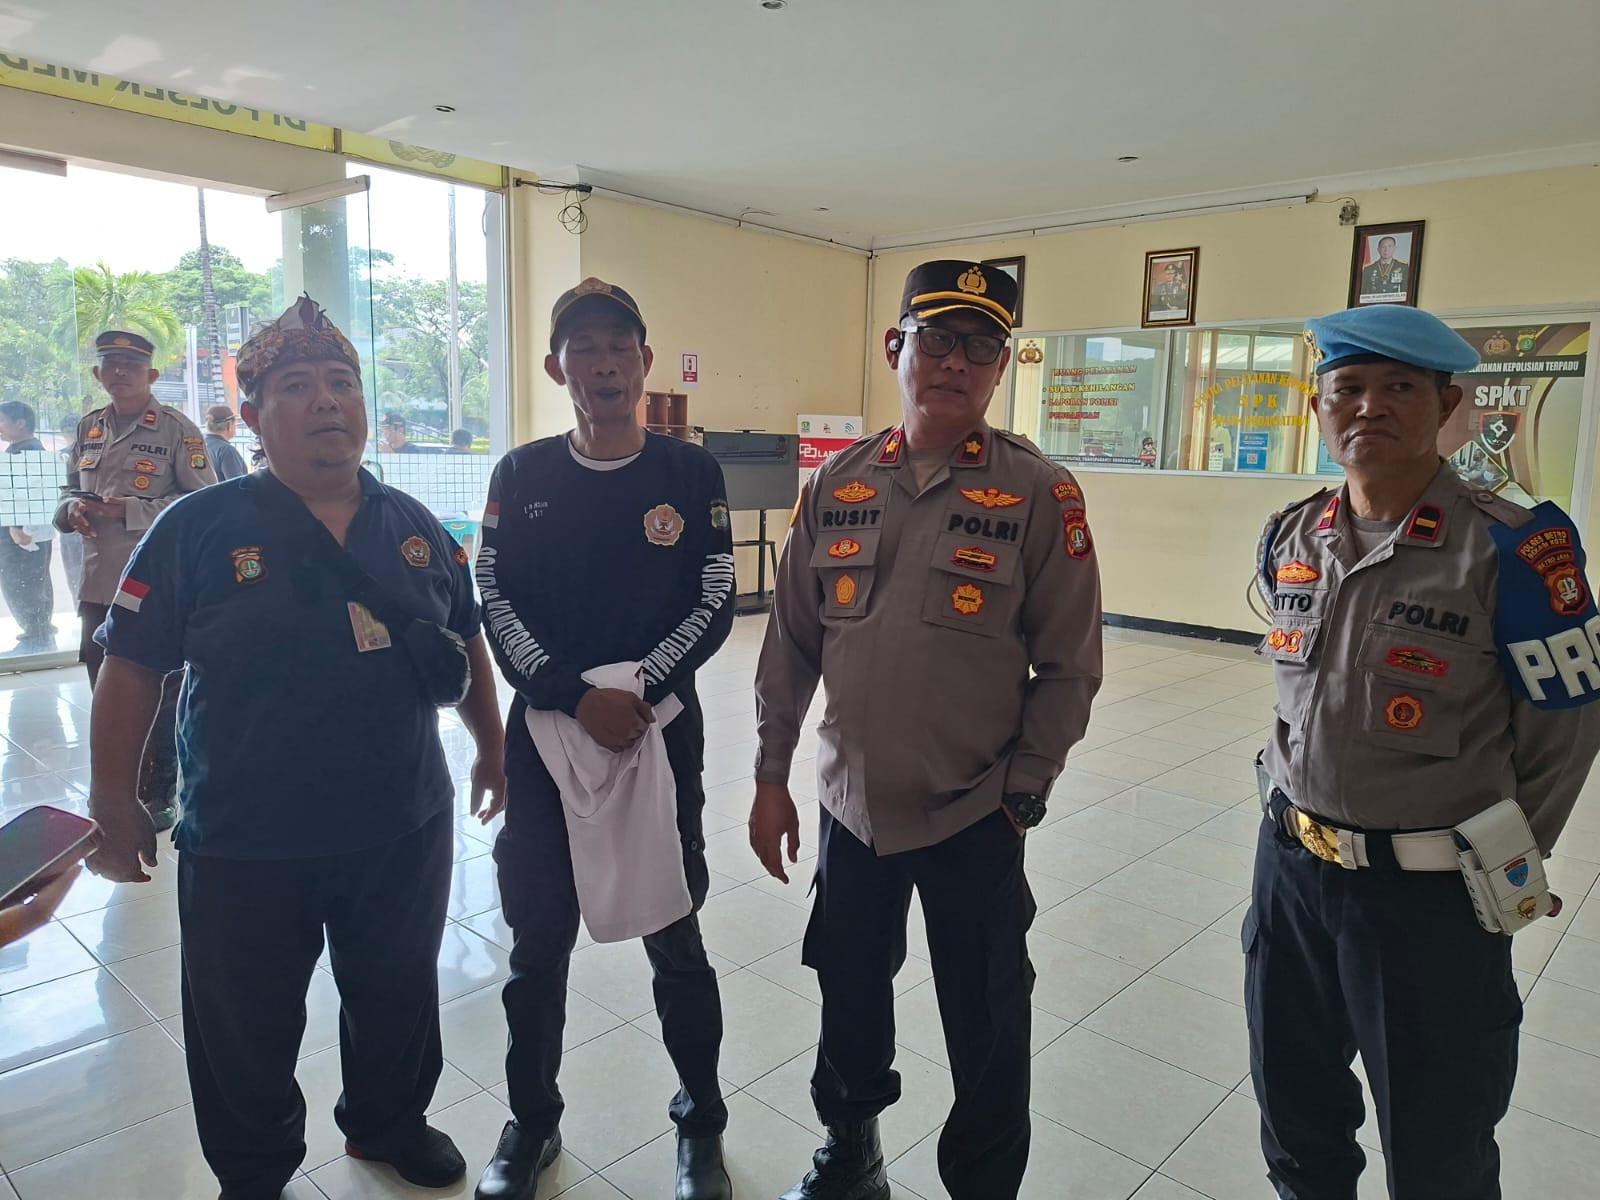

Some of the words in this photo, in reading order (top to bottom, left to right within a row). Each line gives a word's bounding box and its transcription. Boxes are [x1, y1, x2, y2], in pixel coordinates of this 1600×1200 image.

[1502, 361, 1544, 373] KEPOLISIAN
[1546, 360, 1580, 371] TERPADU
[1048, 385, 1077, 393] SURAT
[1078, 383, 1136, 393] KEHILANGAN
[1474, 385, 1531, 407] SPKT
[1048, 398, 1088, 407] LAPORAN
[1090, 398, 1118, 406] POLISI
[130, 443, 168, 456] POLRI
[822, 509, 881, 527] RUSIT
[947, 513, 1019, 541] POLRI
[1274, 592, 1312, 612] OTTO
[1387, 601, 1470, 636] POLRI
